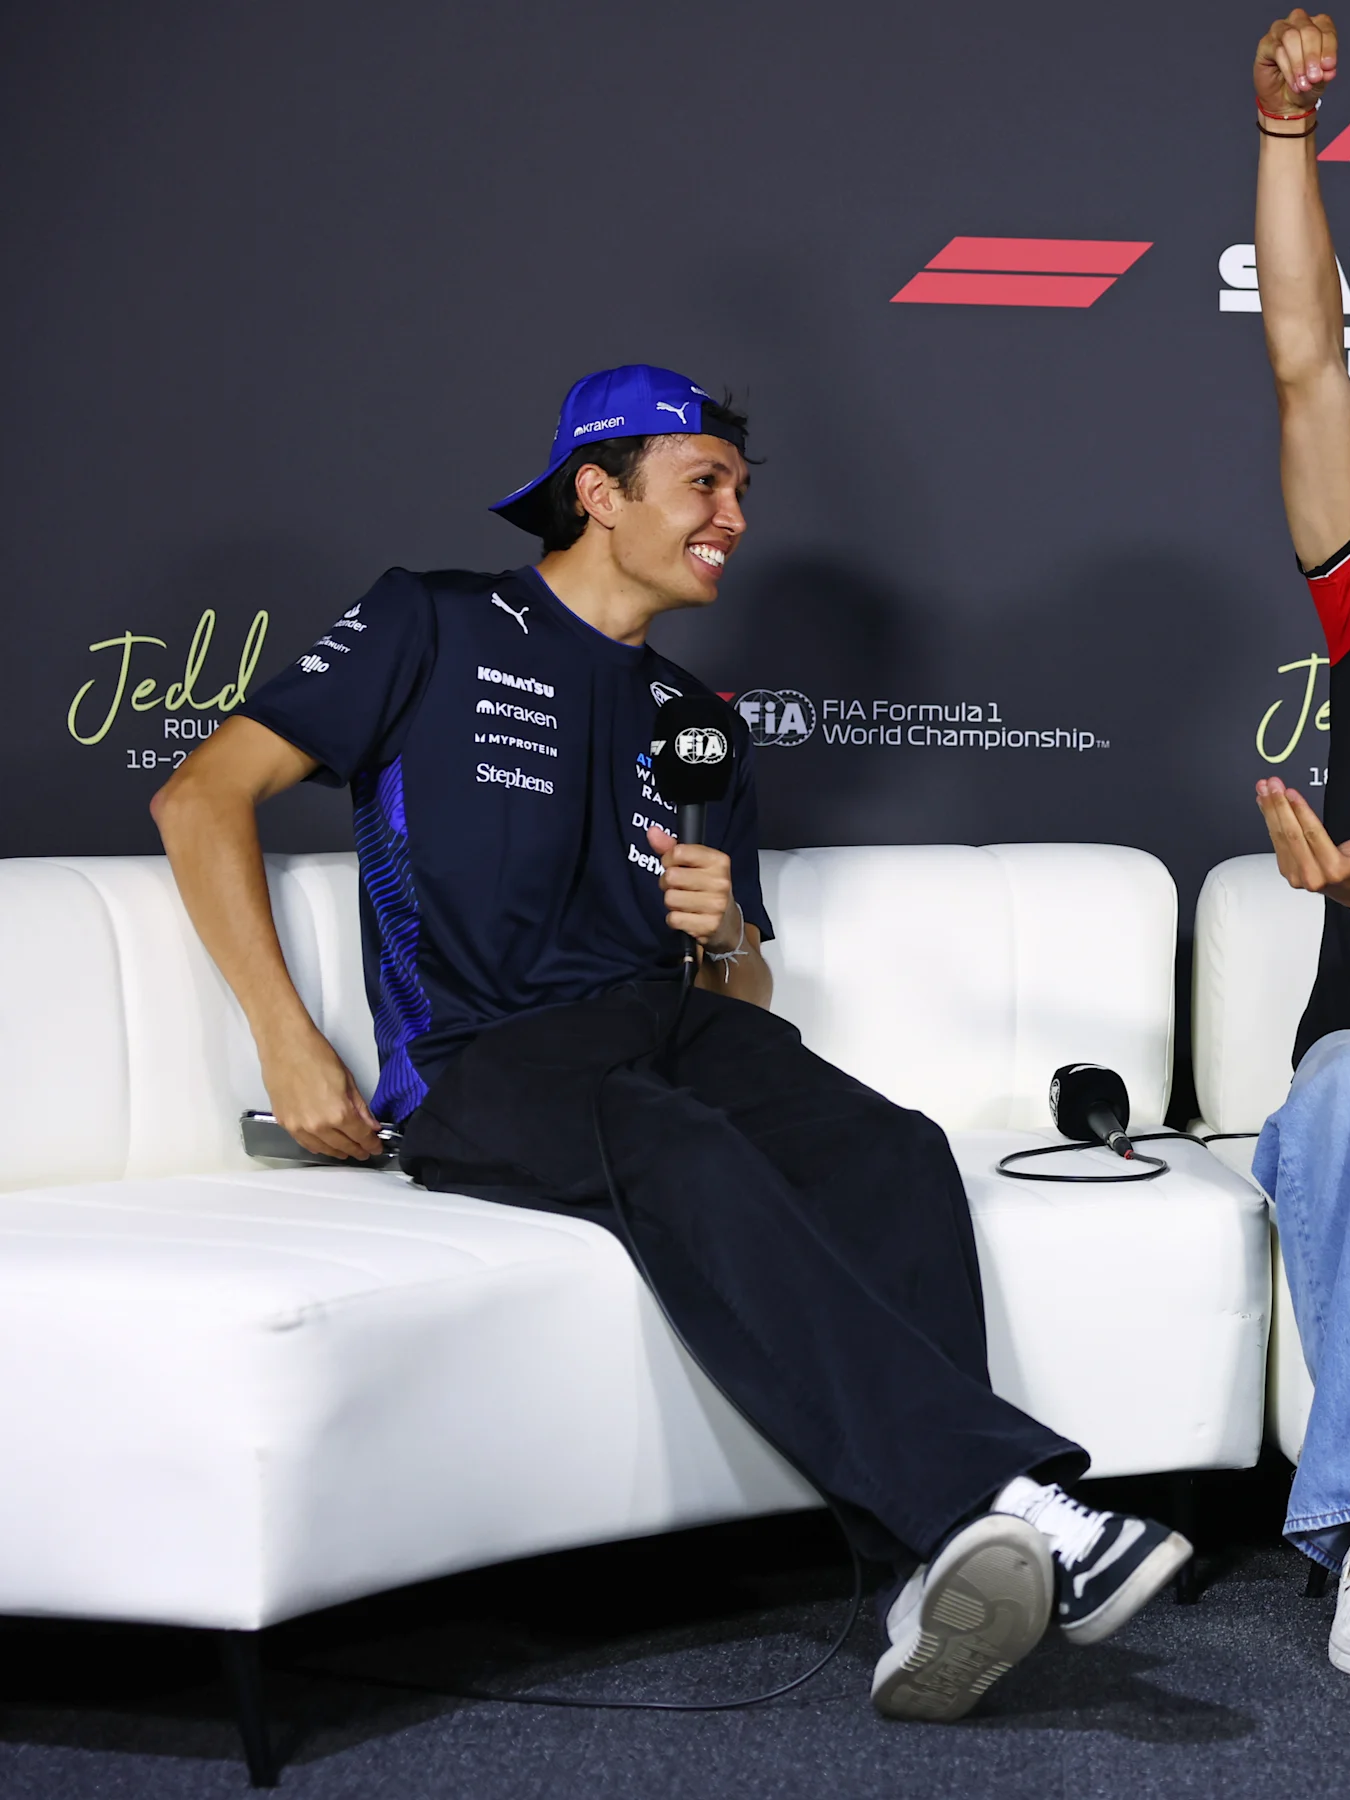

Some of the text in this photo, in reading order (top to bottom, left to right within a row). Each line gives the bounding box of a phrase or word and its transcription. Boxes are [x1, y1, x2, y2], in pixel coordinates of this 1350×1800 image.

[583, 416, 625, 434] kraken
[67, 608, 269, 746] Jedd
[477, 665, 555, 698] KOMATSU
[494, 701, 557, 730] kraken
[823, 699, 1002, 723] FIA Formula 1
[488, 733, 558, 758] MYPROTEIN
[822, 724, 902, 747] World
[906, 725, 1095, 752] Championship
[476, 763, 554, 794] Stephens
